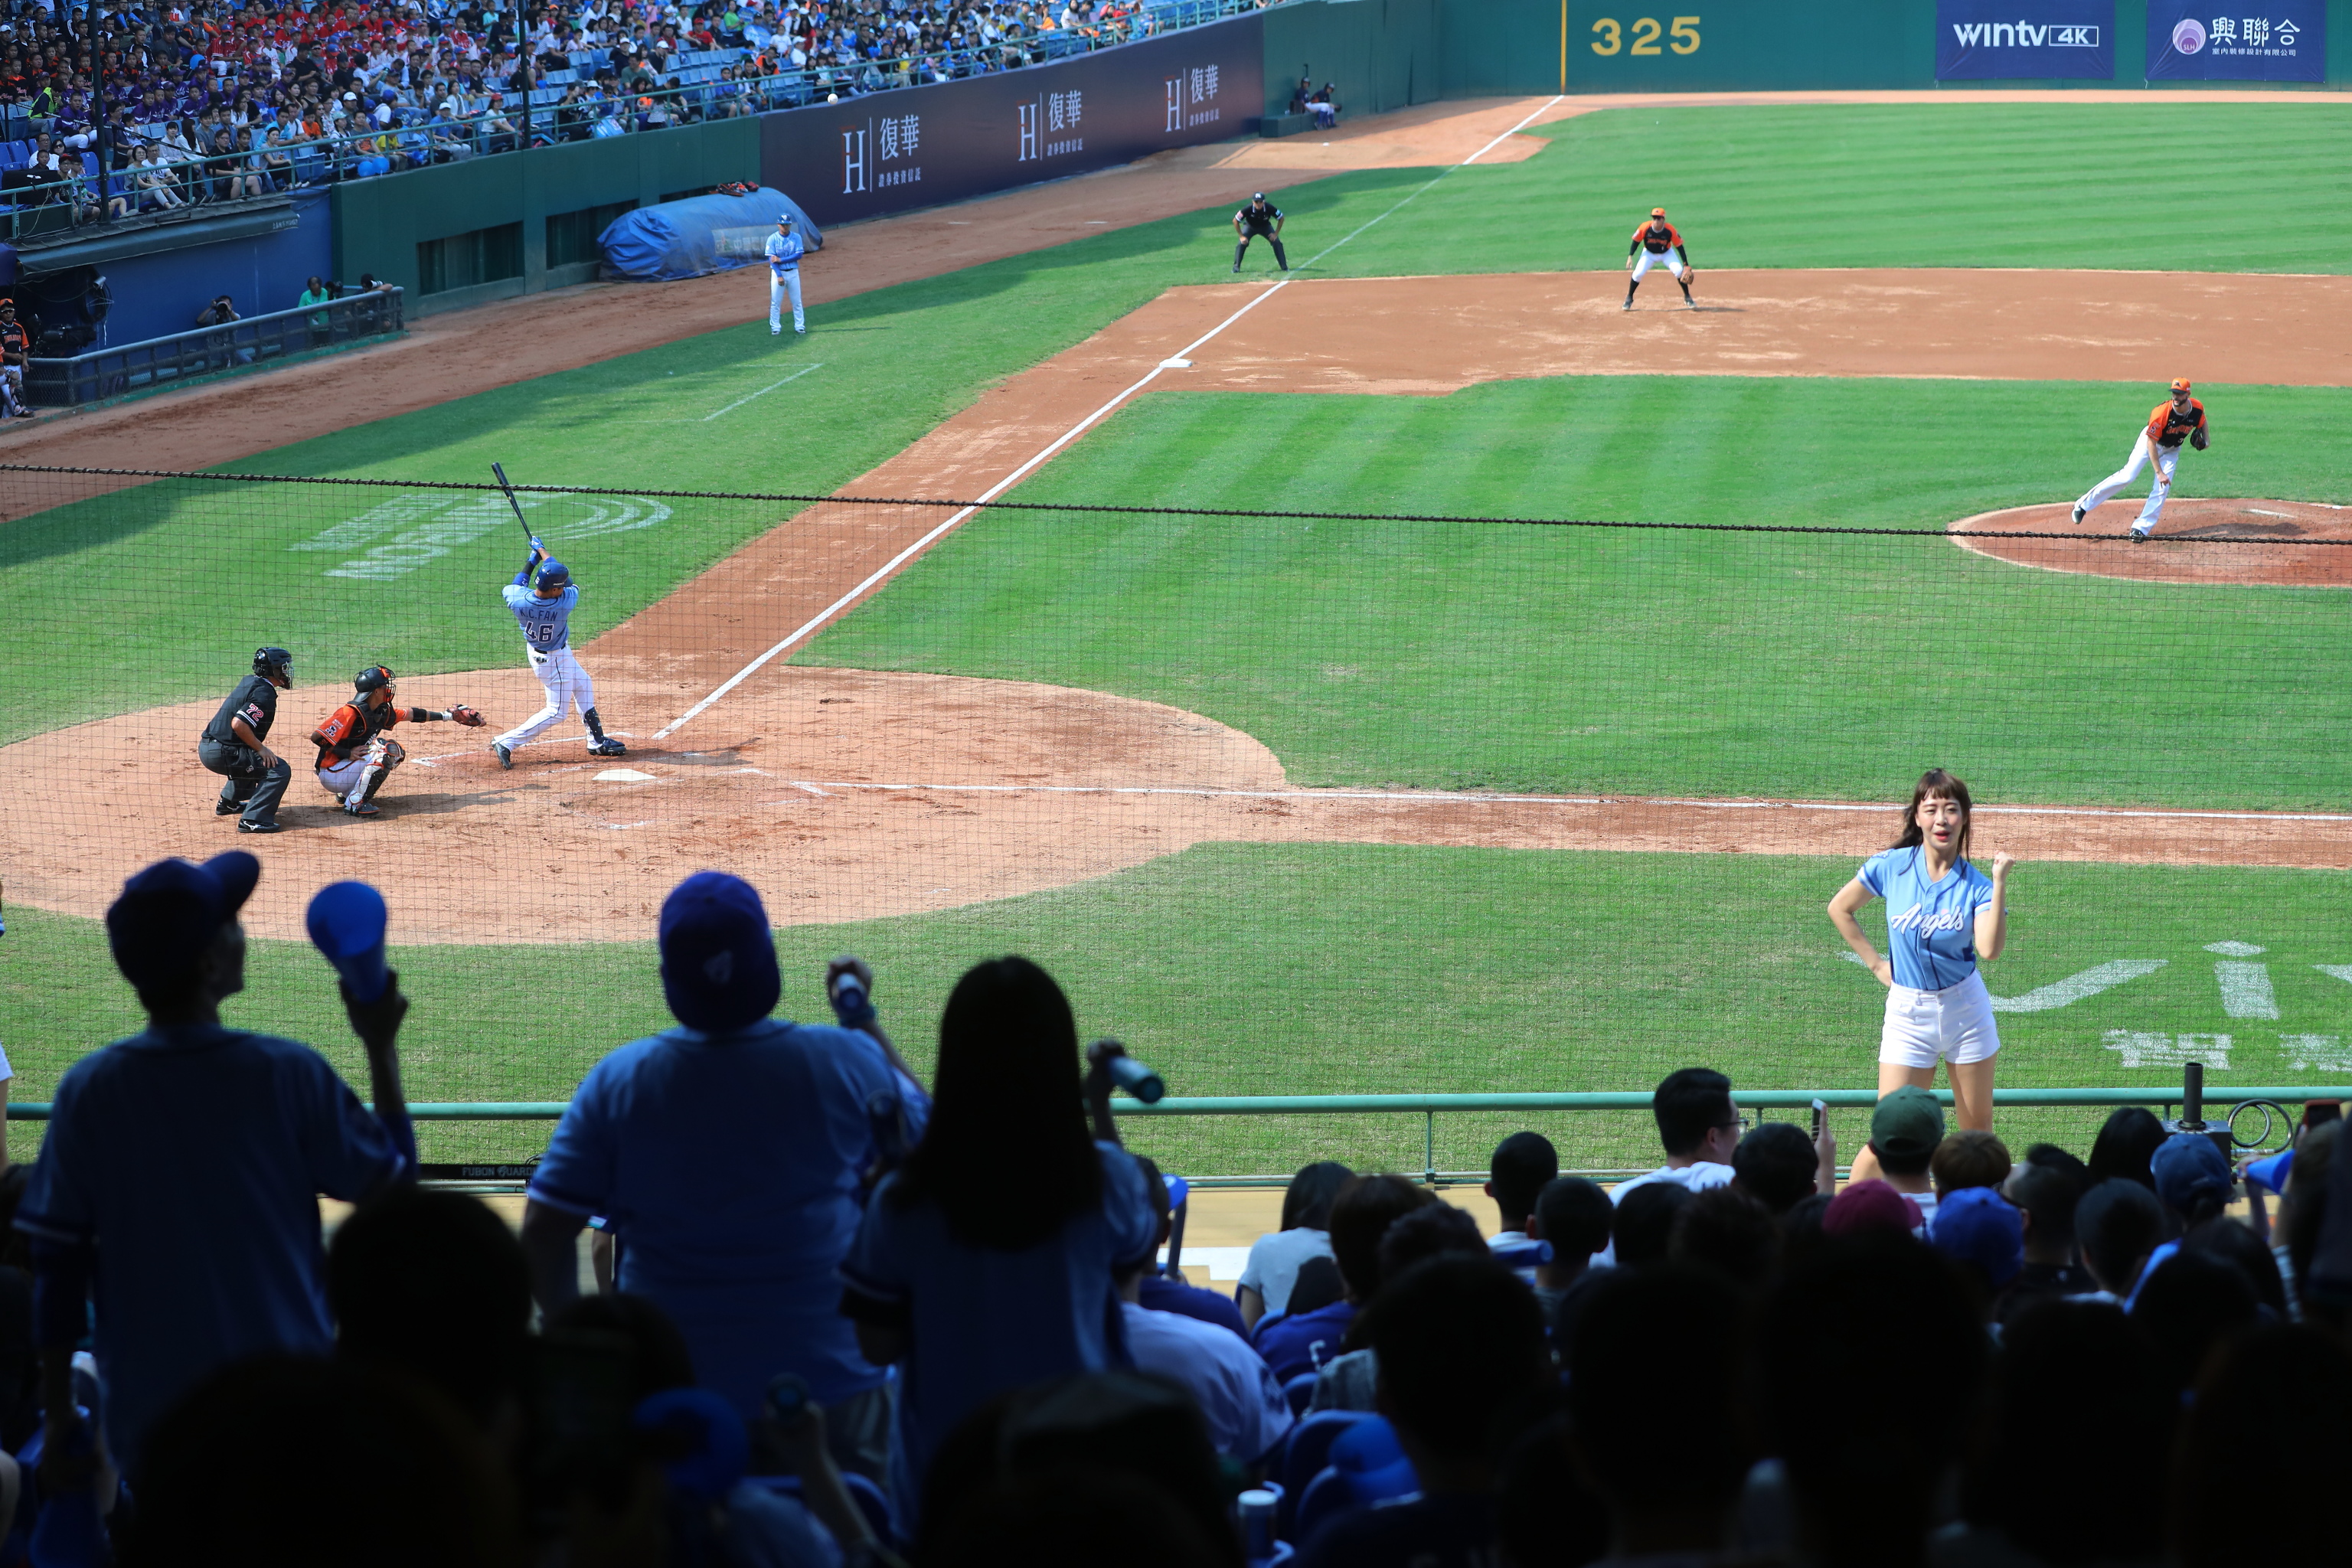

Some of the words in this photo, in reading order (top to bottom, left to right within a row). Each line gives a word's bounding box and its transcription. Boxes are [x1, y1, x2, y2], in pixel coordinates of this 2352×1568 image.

[1591, 16, 1700, 56] 325
[2057, 28, 2089, 44] 4K
[2210, 17, 2300, 47] 興聯合
[1191, 64, 1218, 104] 復華
[1048, 90, 1082, 132] 復華
[880, 114, 920, 161] 復華
[524, 621, 554, 642] 46
[247, 703, 264, 721] 72
[1890, 902, 1964, 939] Angels
[462, 1167, 495, 1176] FUBON
